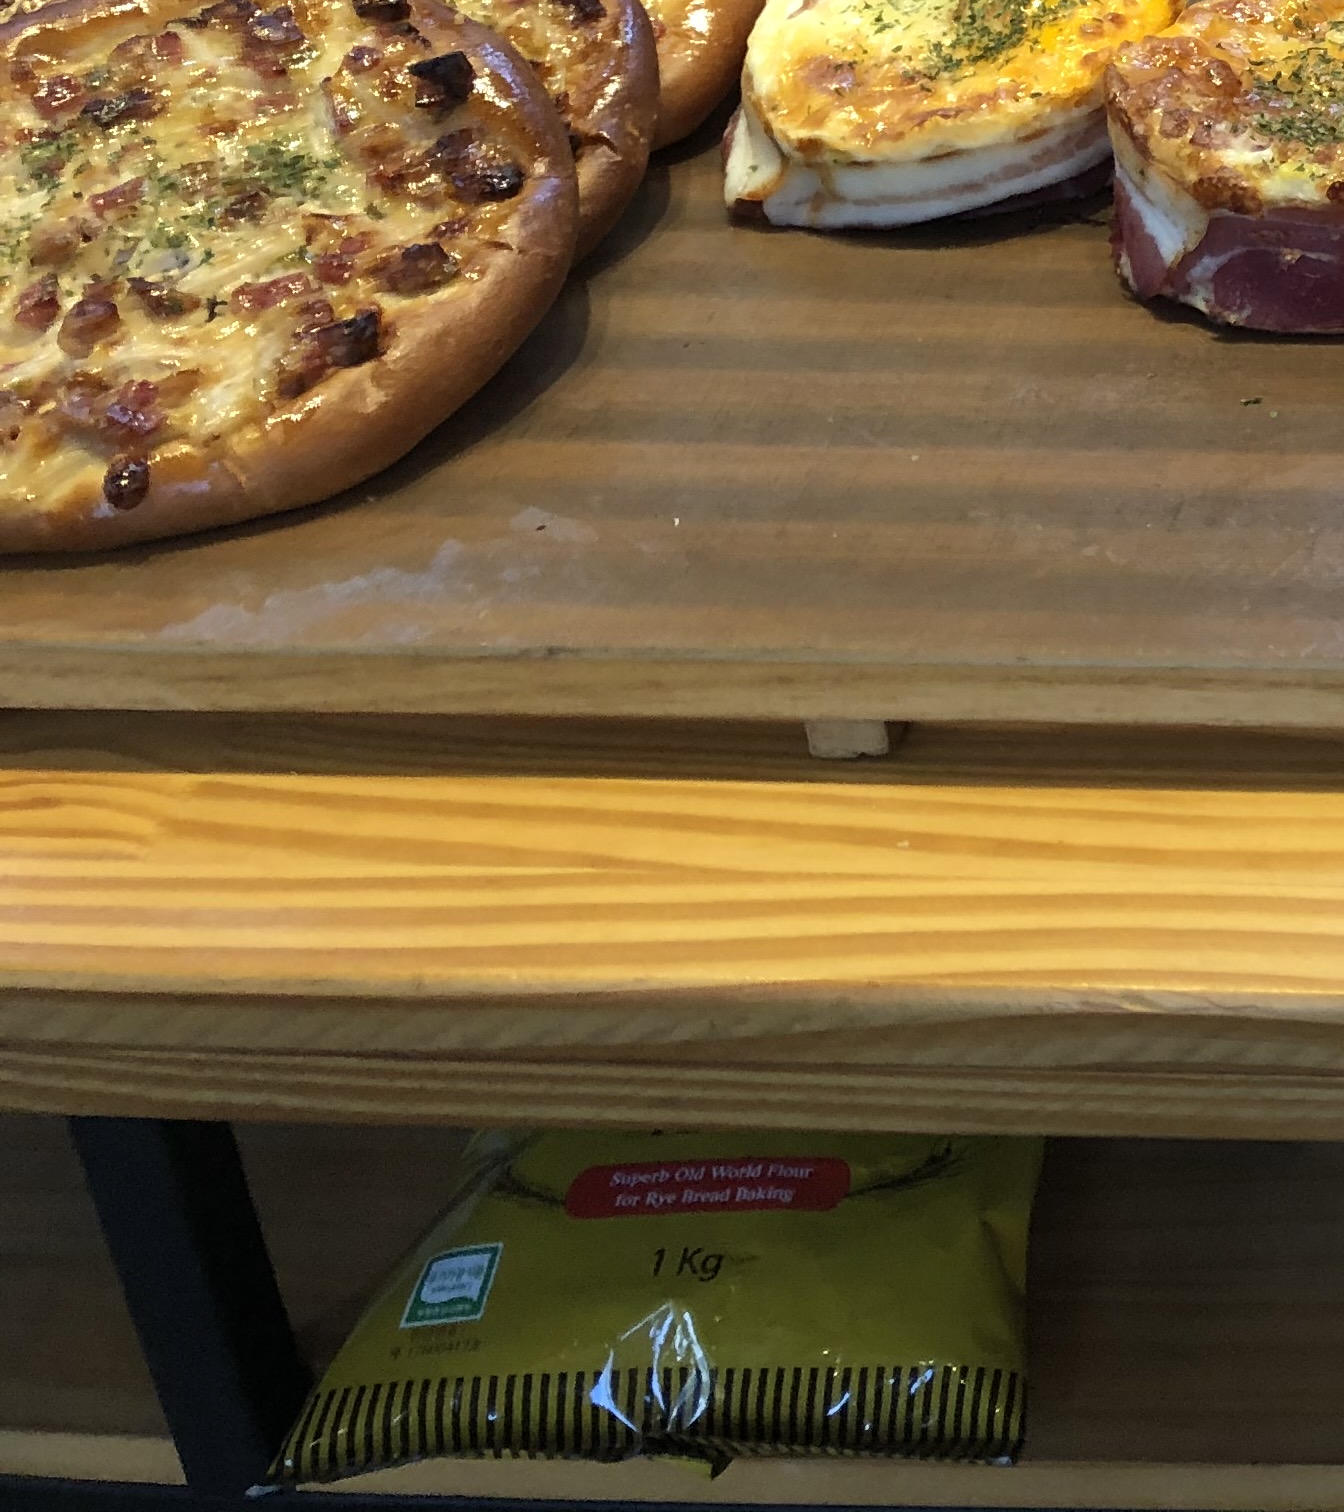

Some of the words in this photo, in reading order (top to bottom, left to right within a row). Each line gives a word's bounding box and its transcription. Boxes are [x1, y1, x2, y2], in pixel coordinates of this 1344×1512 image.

[609, 1169, 670, 1188] Superb
[674, 1167, 704, 1182] Old
[711, 1164, 762, 1181] World
[767, 1163, 814, 1180] Flour
[614, 1192, 638, 1208] for
[645, 1191, 677, 1209] Rye
[681, 1188, 730, 1204] Bread
[735, 1186, 795, 1204] Baking
[653, 1247, 666, 1277] 1
[676, 1247, 724, 1283] Kg
